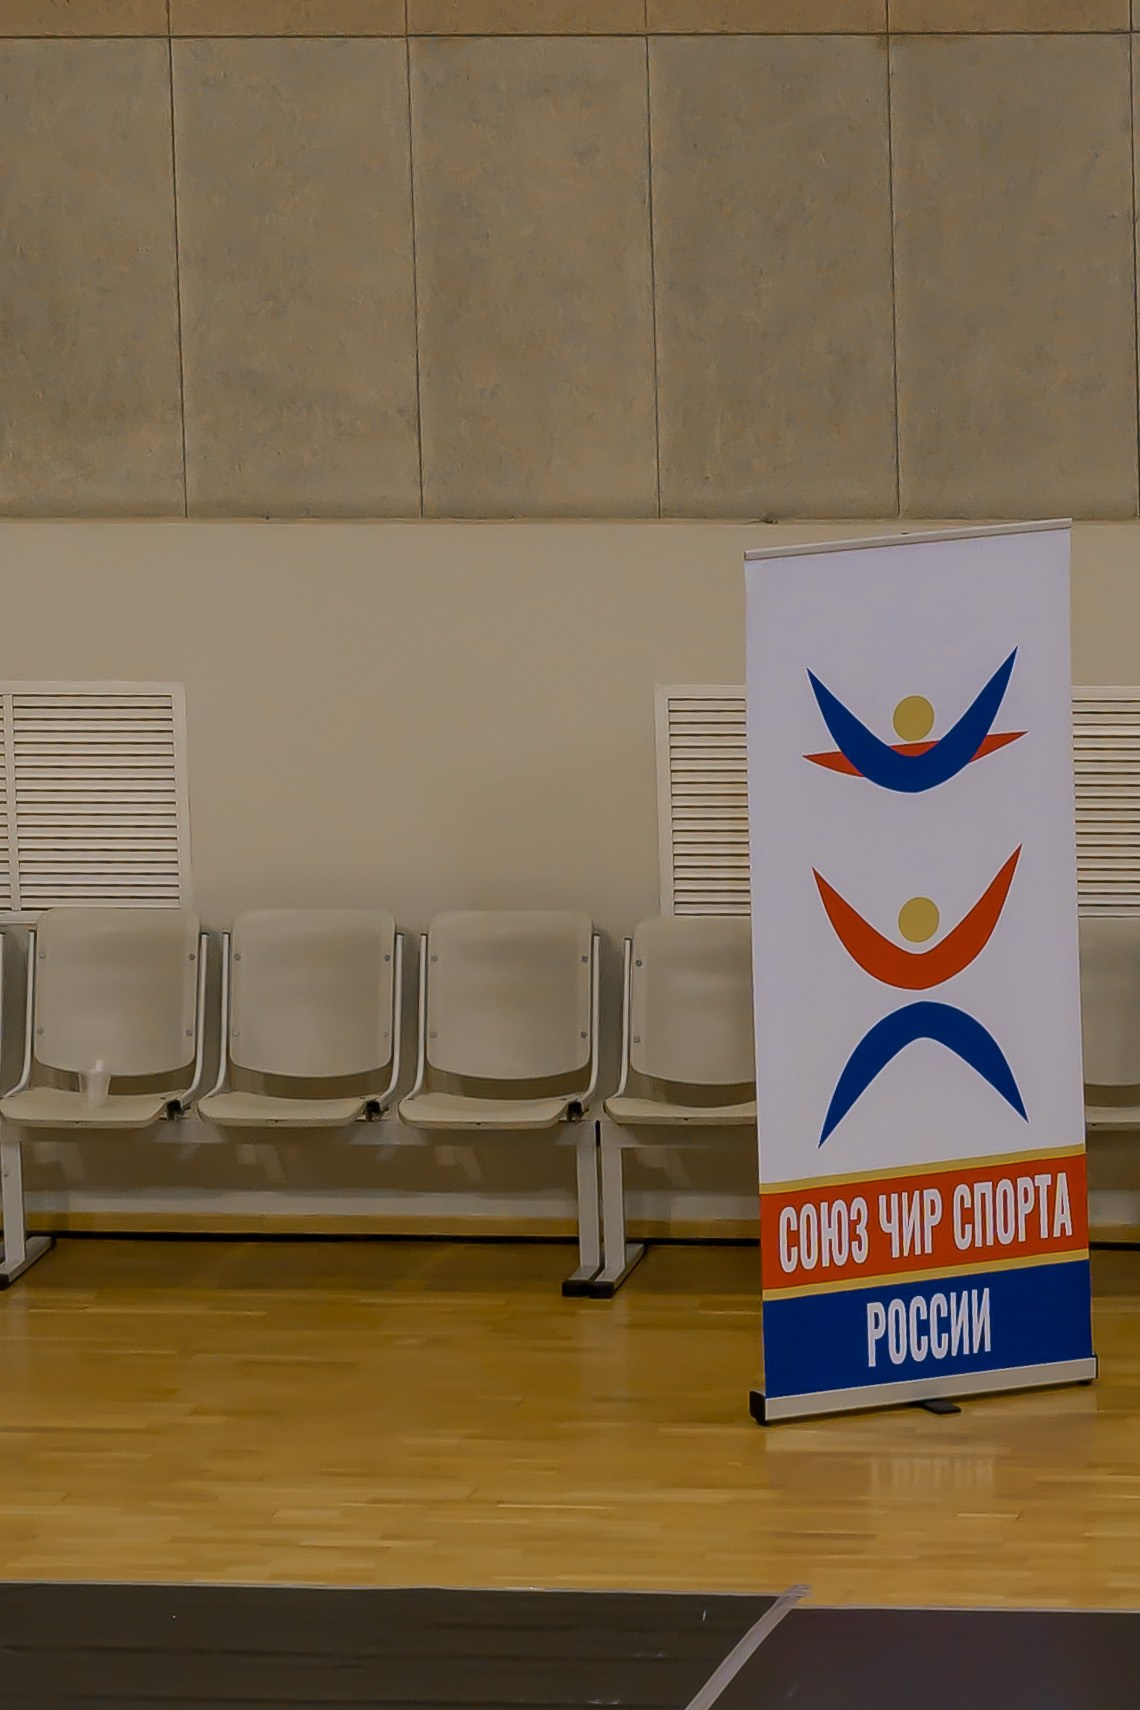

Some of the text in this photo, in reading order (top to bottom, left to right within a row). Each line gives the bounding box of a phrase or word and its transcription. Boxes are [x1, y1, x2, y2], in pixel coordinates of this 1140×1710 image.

[779, 1172, 1073, 1273] СОЮЗ ЧИР СПОРТА
[866, 1288, 992, 1367] РОССИИ
